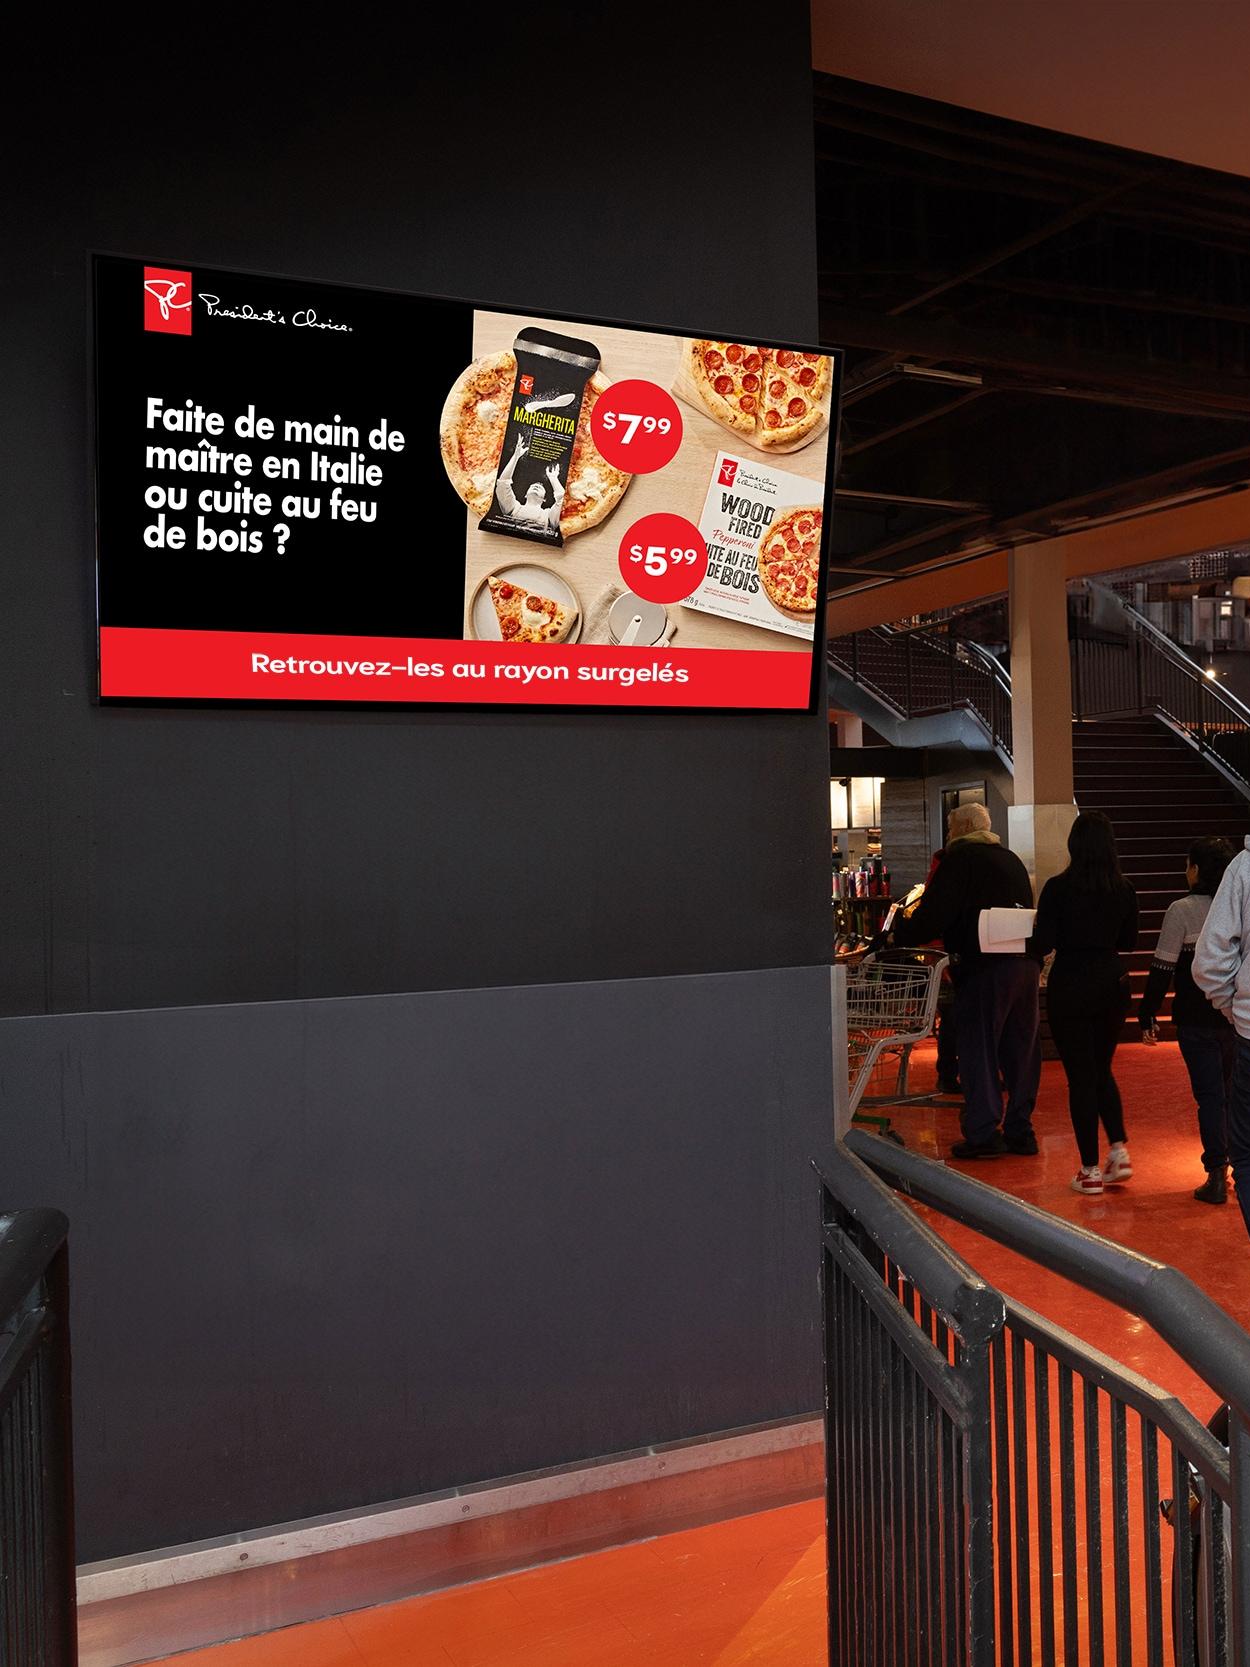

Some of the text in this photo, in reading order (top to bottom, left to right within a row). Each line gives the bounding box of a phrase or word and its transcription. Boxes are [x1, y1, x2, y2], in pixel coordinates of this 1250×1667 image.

[198, 293, 348, 332] President's Choice
[146, 396, 406, 453] Faite de main de
[513, 406, 575, 435] MARGHERITA
[145, 438, 383, 487] maître en Italie
[144, 480, 377, 523] ou cuite au feu
[720, 492, 776, 526] WOOD
[143, 512, 291, 555] de bois ?
[713, 529, 757, 550] Pepperoni
[728, 516, 763, 539] FIRED
[725, 549, 740, 566] AU
[739, 553, 759, 572] FEU
[706, 562, 761, 594] DE BOIS
[452, 663, 486, 678] au
[494, 664, 569, 684] rayon
[577, 662, 689, 687] surgelés
